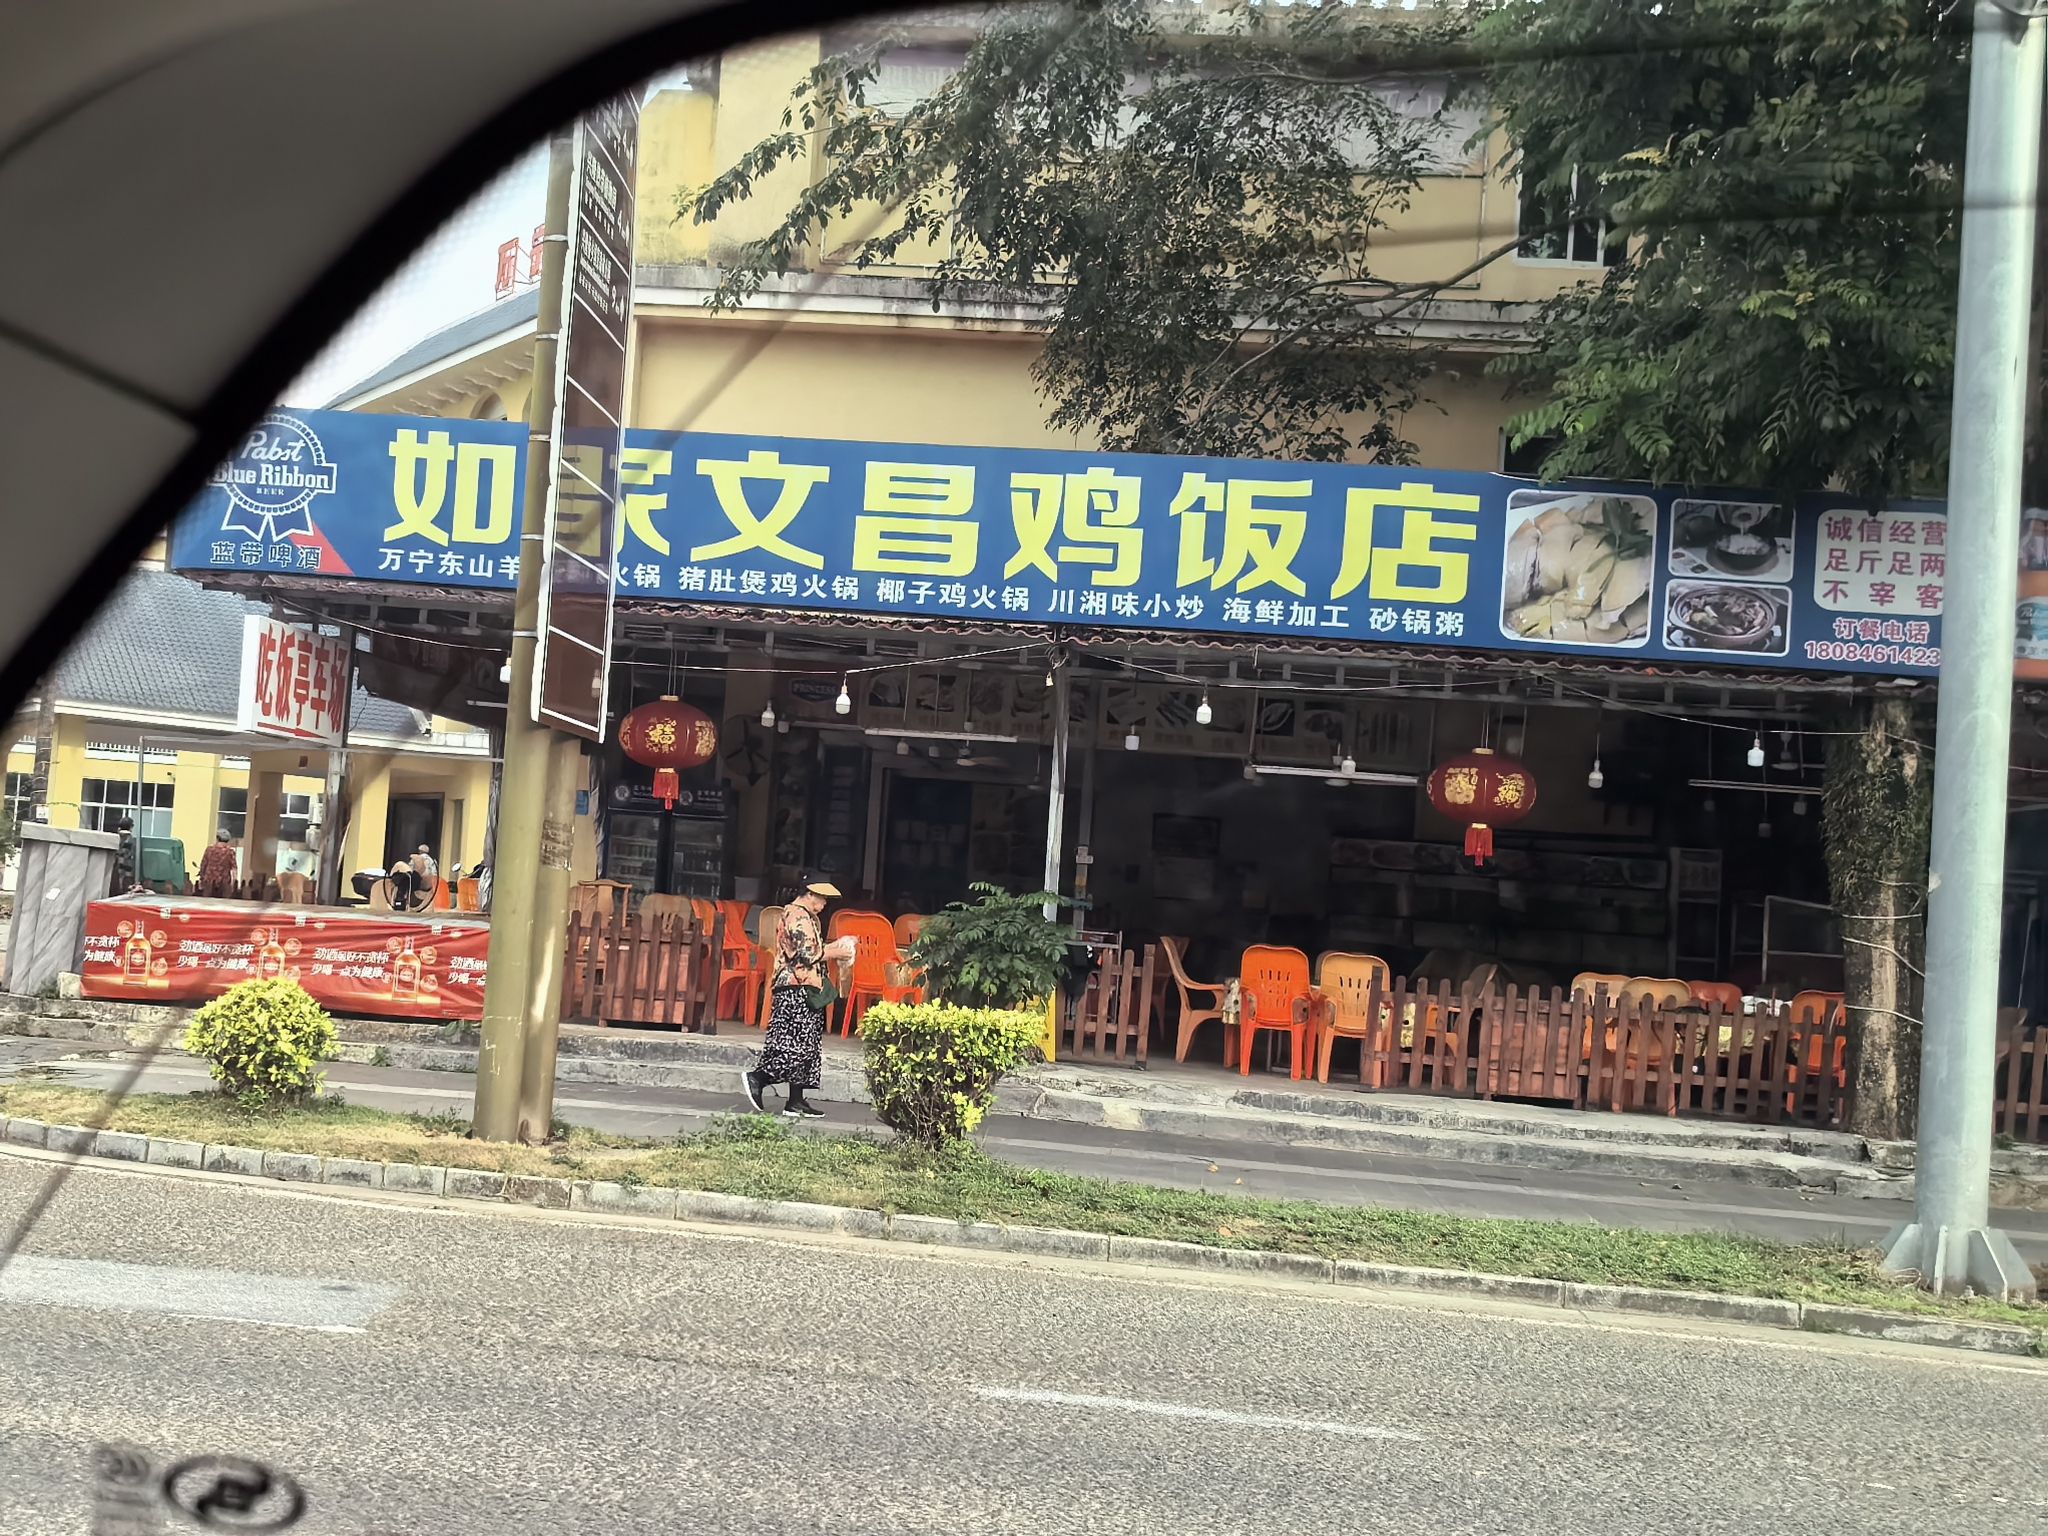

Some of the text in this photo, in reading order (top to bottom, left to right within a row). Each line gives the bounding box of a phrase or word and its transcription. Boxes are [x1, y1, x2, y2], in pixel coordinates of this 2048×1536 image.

[240, 430, 306, 462] Pabst
[259, 463, 330, 489] Ribbon
[256, 487, 285, 496] BEER
[1825, 516, 1947, 546] 诚信经营
[210, 541, 322, 569] 蓝带啤酒
[1823, 548, 1946, 578] 足斤足两
[678, 565, 860, 601] 猪肚煲鸡火锅
[876, 580, 1030, 612] 椰子鸡火锅
[1047, 588, 1205, 620] 川湘味小炒
[1222, 597, 1350, 628] 海鲜加工
[1368, 607, 1465, 637] 砂锅粥
[1822, 580, 1944, 609] 不宰客
[1833, 617, 1930, 644] 订餐电话
[84, 935, 121, 948] 不贪杯
[447, 956, 488, 970] 劲酒虽
